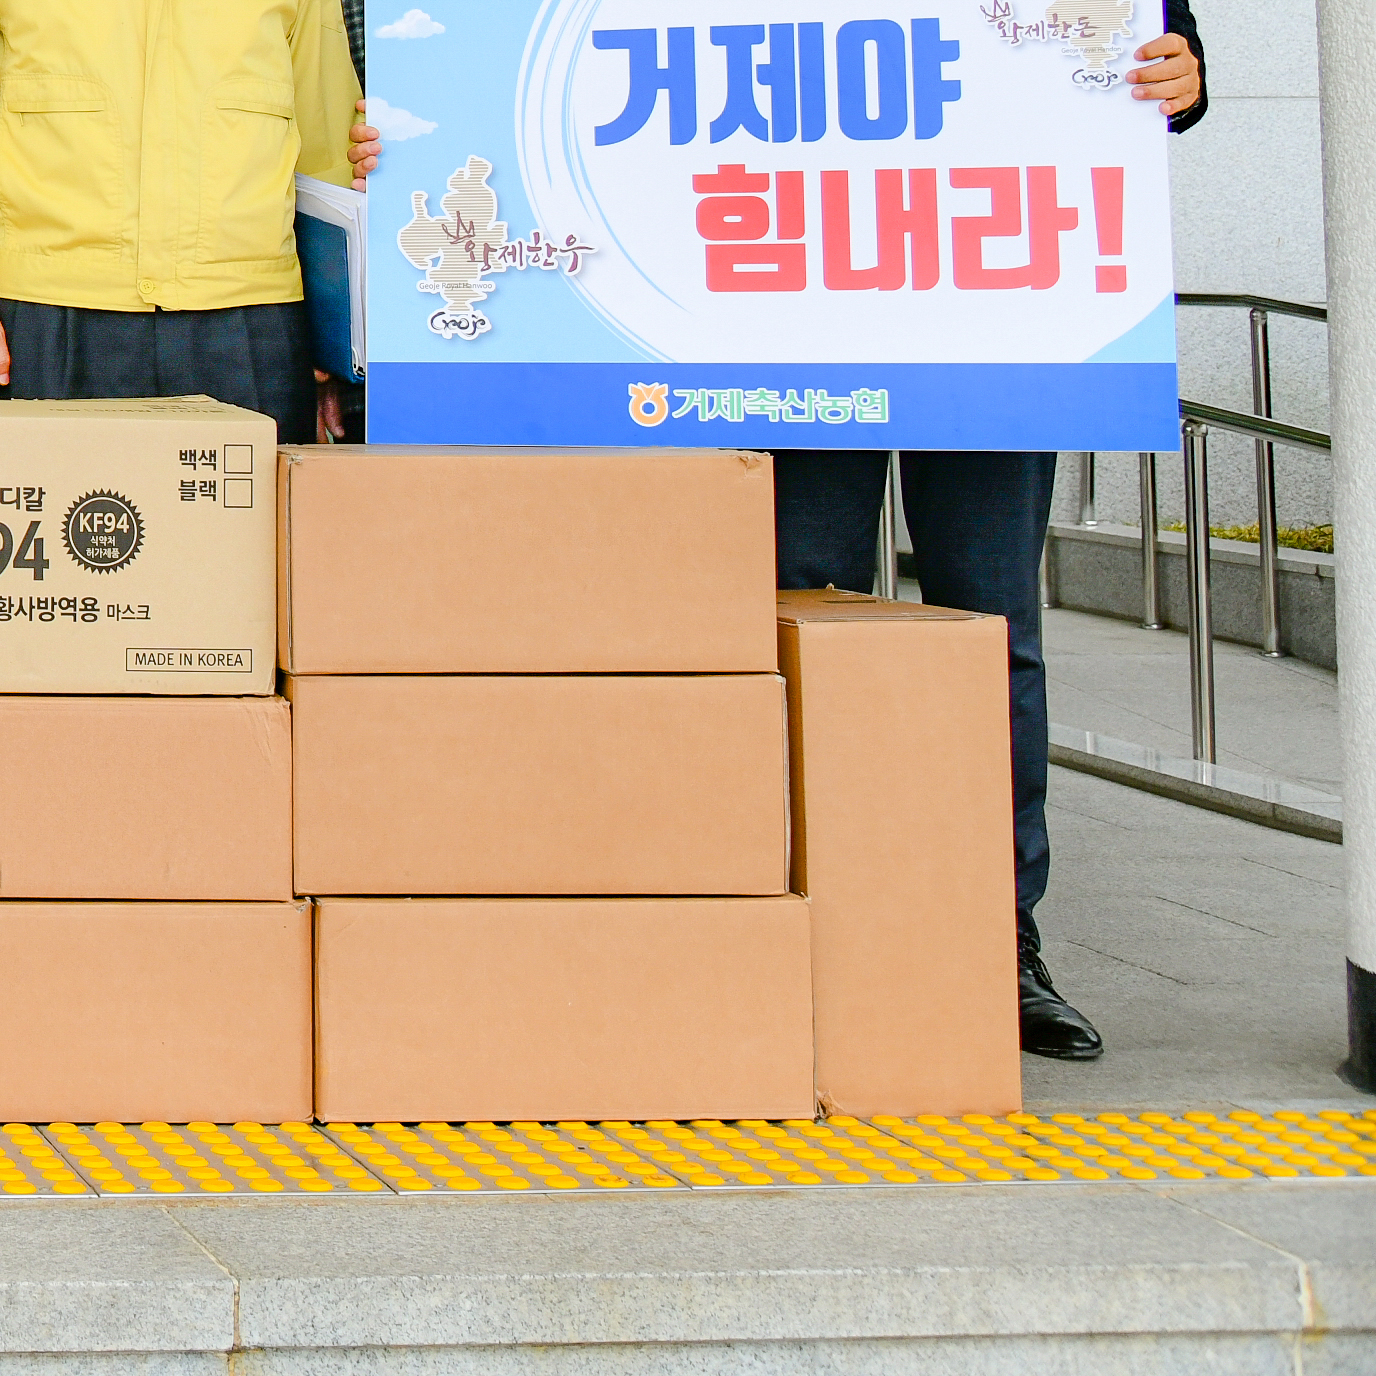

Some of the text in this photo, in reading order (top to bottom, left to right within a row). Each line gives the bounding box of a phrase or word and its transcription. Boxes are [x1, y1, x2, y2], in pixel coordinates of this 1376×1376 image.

[592, 18, 961, 146] 거제야
[692, 164, 1127, 293] 힘내라!
[671, 386, 890, 426] 거제축산농협
[179, 449, 216, 471] 백색
[178, 480, 216, 501] 블랙
[78, 511, 131, 535] KF94
[90, 534, 117, 547] 식약처
[85, 546, 121, 559] 허가제품
[107, 604, 151, 621] 마스크
[135, 653, 243, 666] MADE IN KOREA
